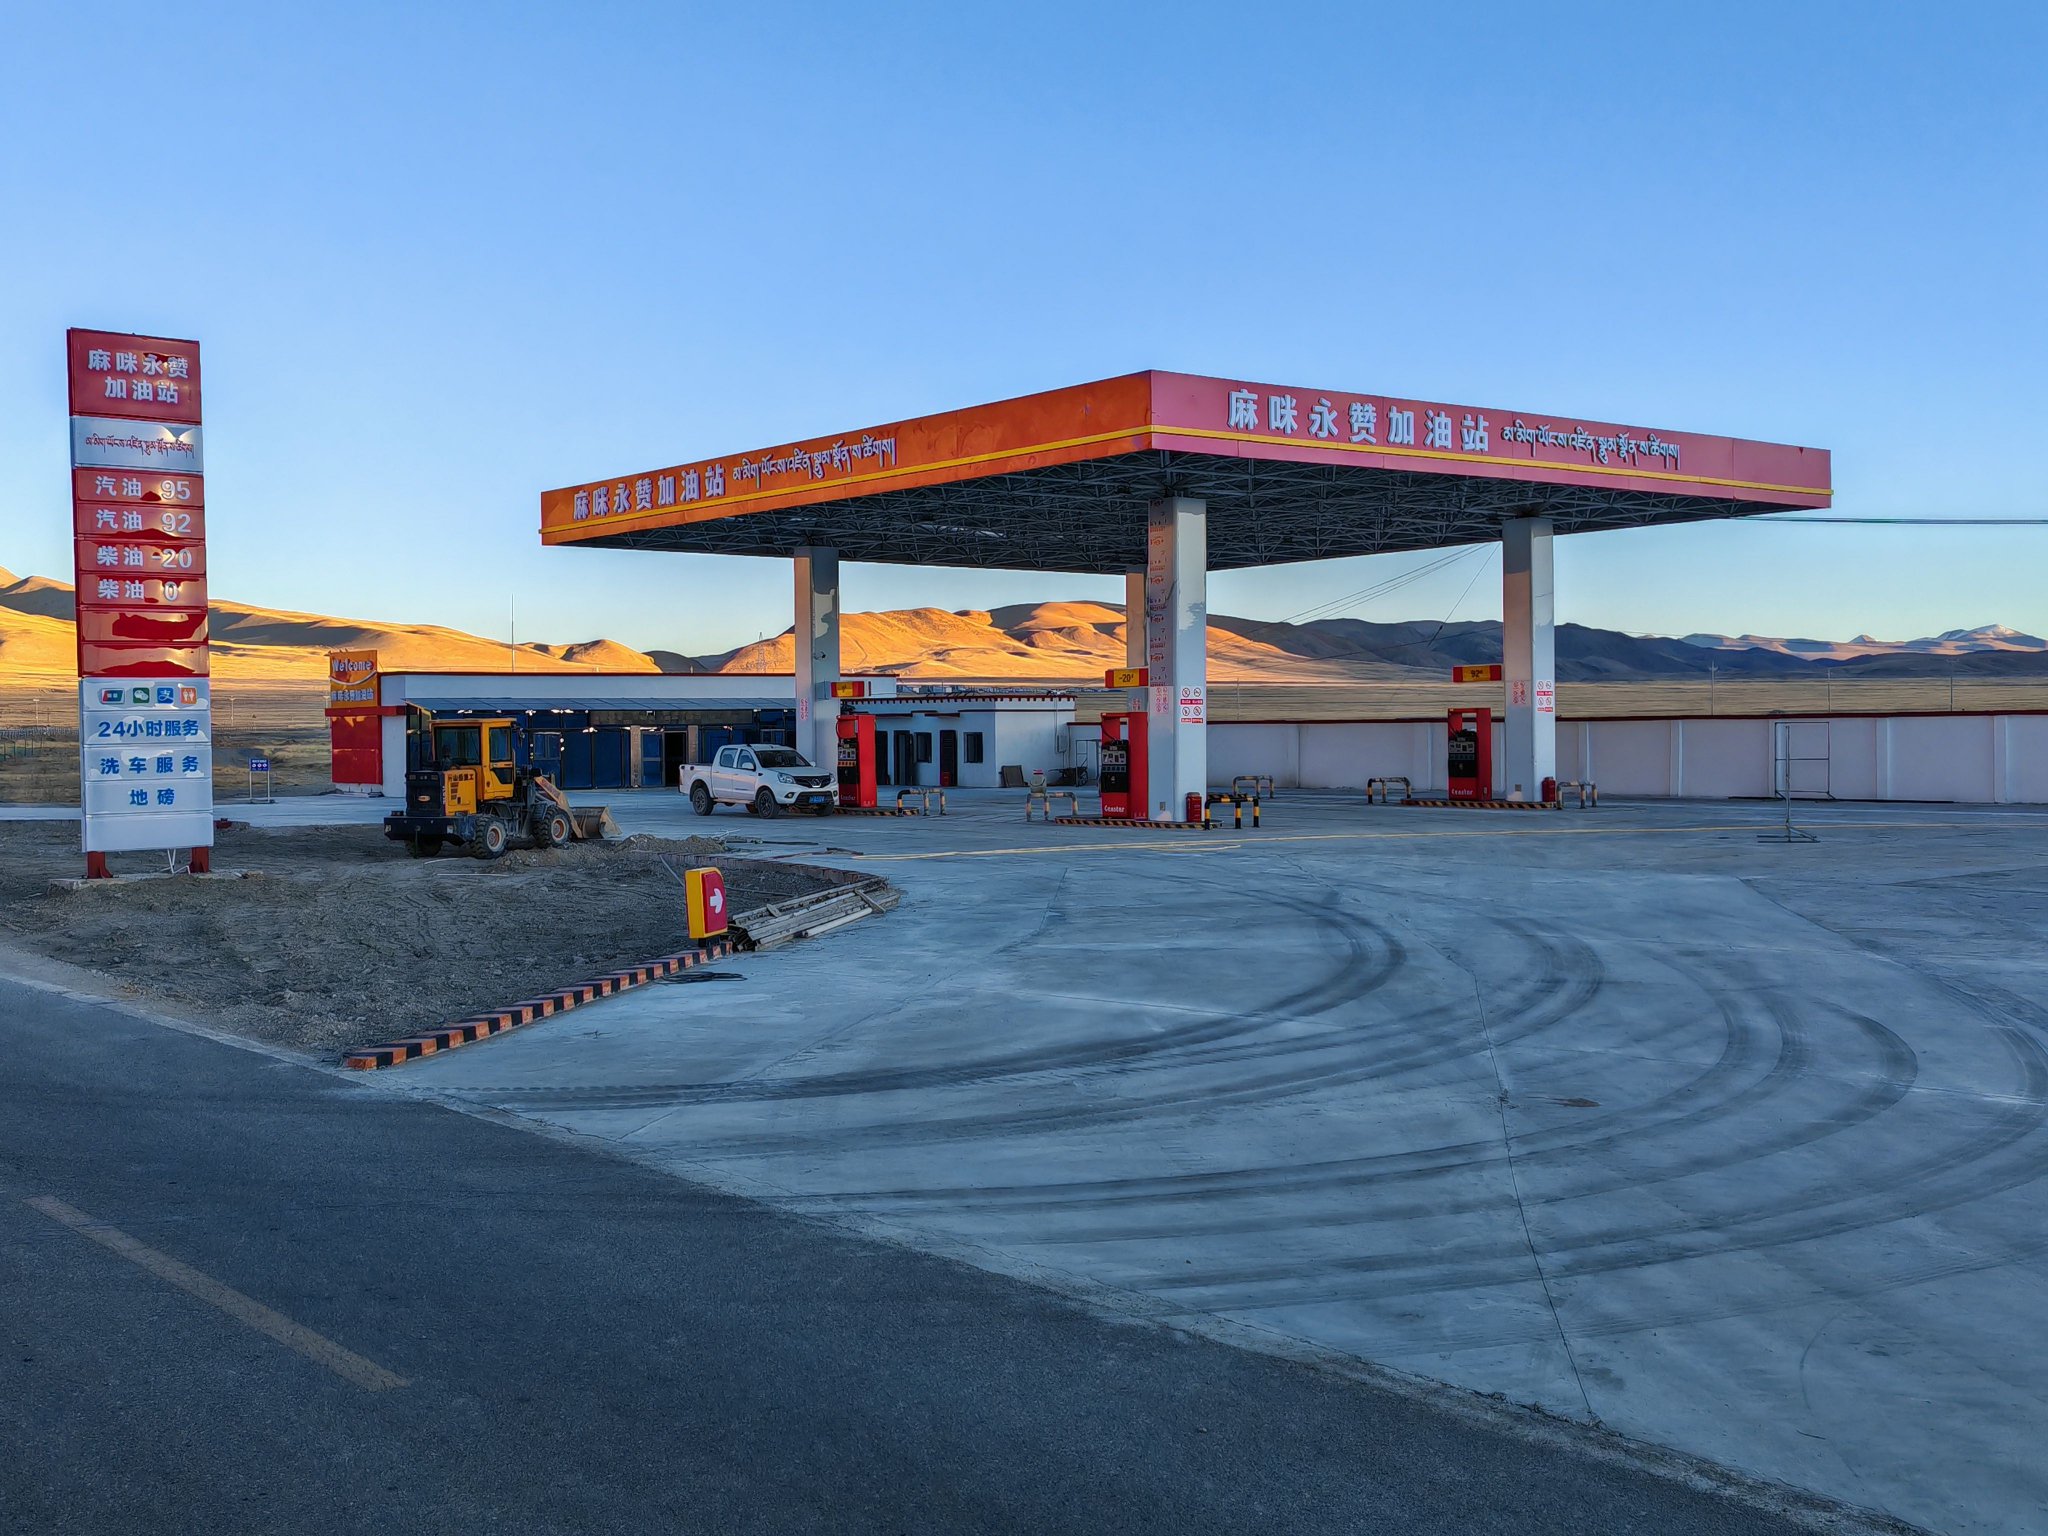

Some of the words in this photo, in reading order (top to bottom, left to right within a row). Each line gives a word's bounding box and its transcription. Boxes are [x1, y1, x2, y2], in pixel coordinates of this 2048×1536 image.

[88, 349, 188, 378] 麻咪永赞
[104, 376, 179, 404] 加油站
[1227, 388, 1490, 453] 麻咪永赞加油站
[95, 475, 142, 497] 汽油
[161, 480, 191, 500] 95
[572, 463, 727, 521] 麻咪永赞加油站
[96, 509, 143, 530] 汽油
[161, 512, 192, 533] 92
[96, 545, 144, 567] 柴油
[151, 549, 192, 569] -20
[97, 579, 145, 600] 柴油
[164, 581, 179, 601] 0
[332, 658, 372, 672] Welcome
[98, 719, 199, 738] 24小时服务
[99, 756, 199, 775] 洗车服务
[129, 788, 175, 806] 地磅
